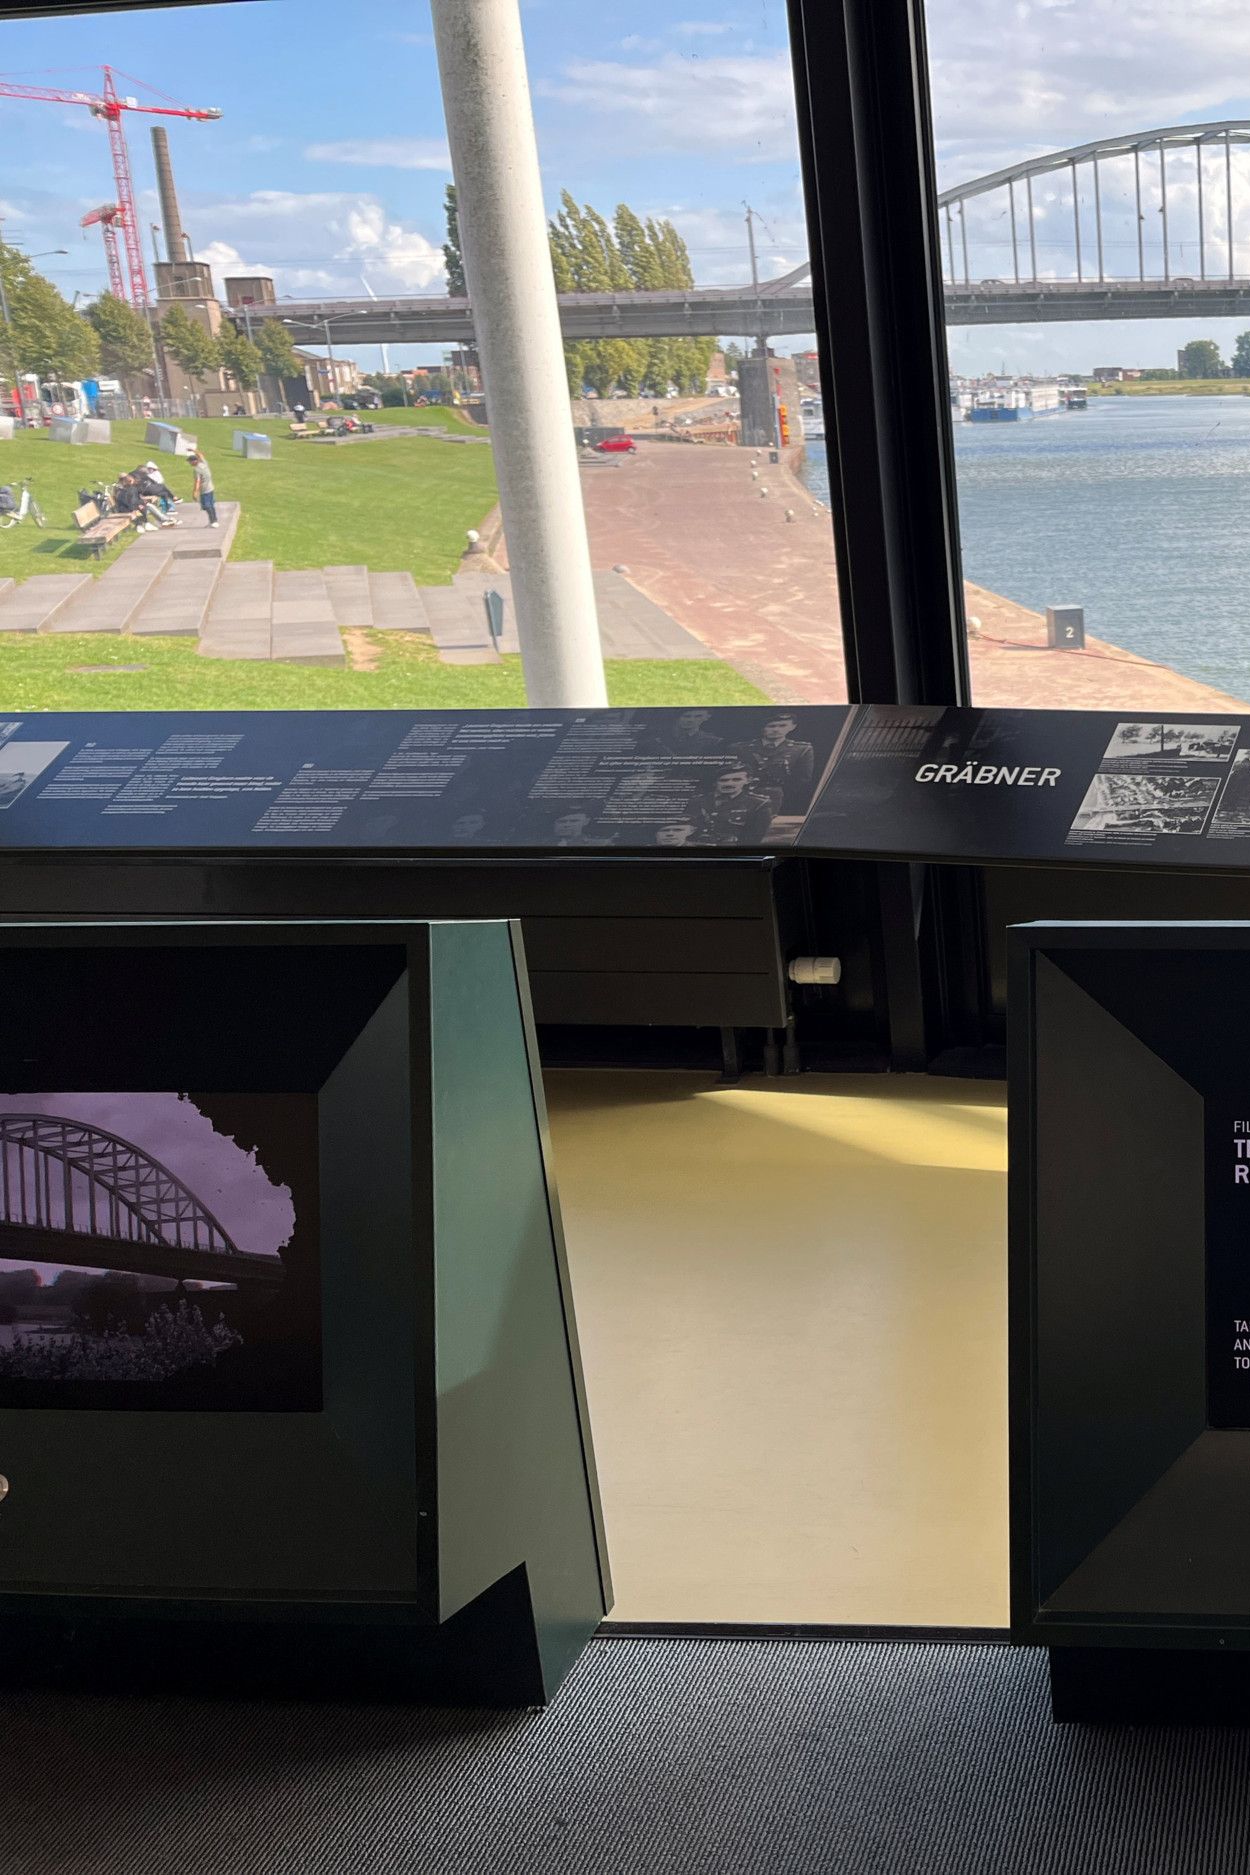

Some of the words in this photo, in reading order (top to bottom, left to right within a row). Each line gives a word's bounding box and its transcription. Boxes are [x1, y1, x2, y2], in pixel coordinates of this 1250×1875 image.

[1065, 626, 1075, 639] 2
[914, 760, 1062, 787] GRÄBNER
[1233, 1356, 1250, 1370] TO
